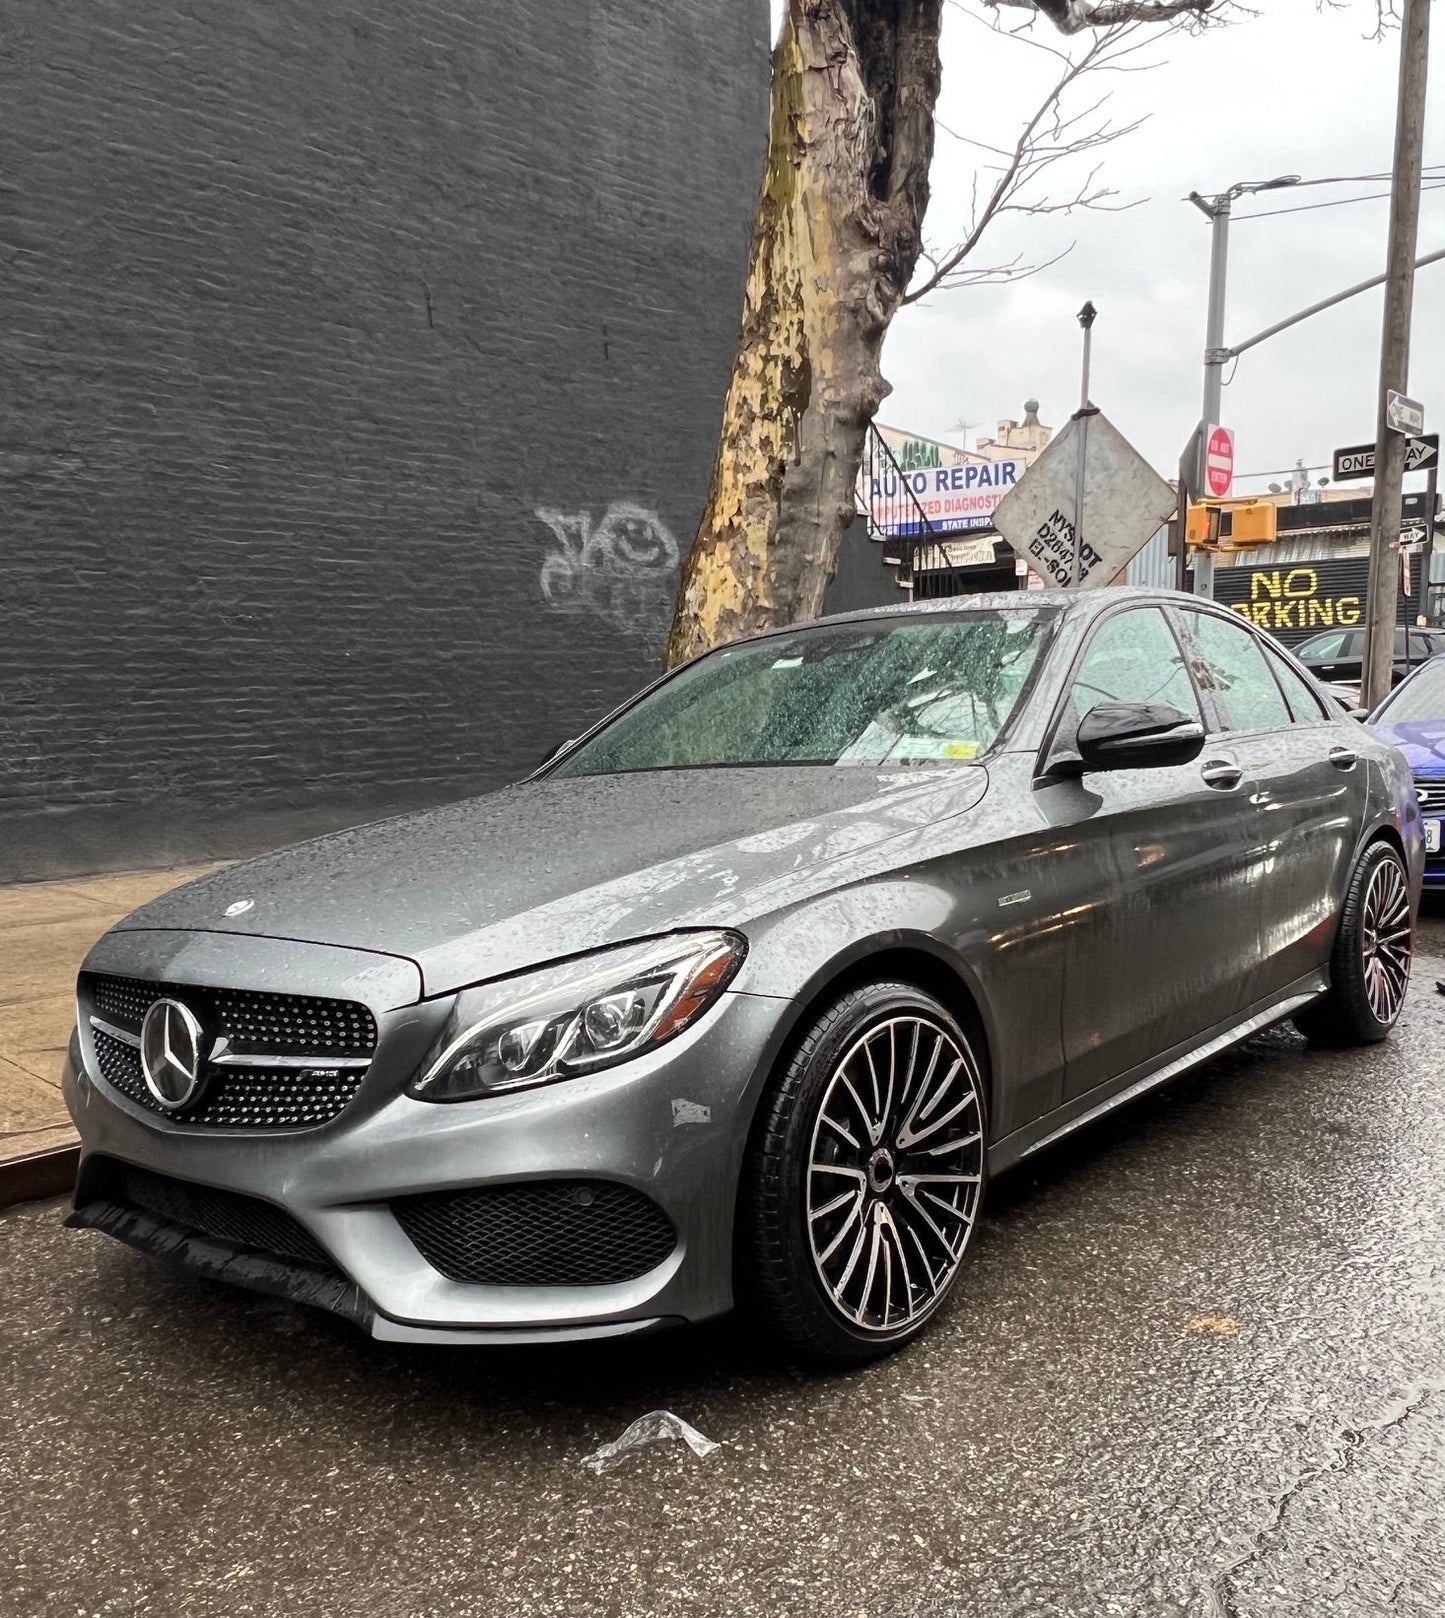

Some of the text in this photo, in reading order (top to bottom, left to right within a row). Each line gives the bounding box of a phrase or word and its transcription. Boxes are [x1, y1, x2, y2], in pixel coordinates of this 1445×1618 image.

[1342, 446, 1426, 470] ONE AY
[870, 462, 1016, 499] AUTO REPAIR
[944, 494, 1001, 515] DIAGNOSTI
[942, 516, 993, 530] STATE INSP
[1403, 532, 1420, 540] WAY
[1251, 569, 1318, 599] NO
[1231, 597, 1360, 628] RKING
